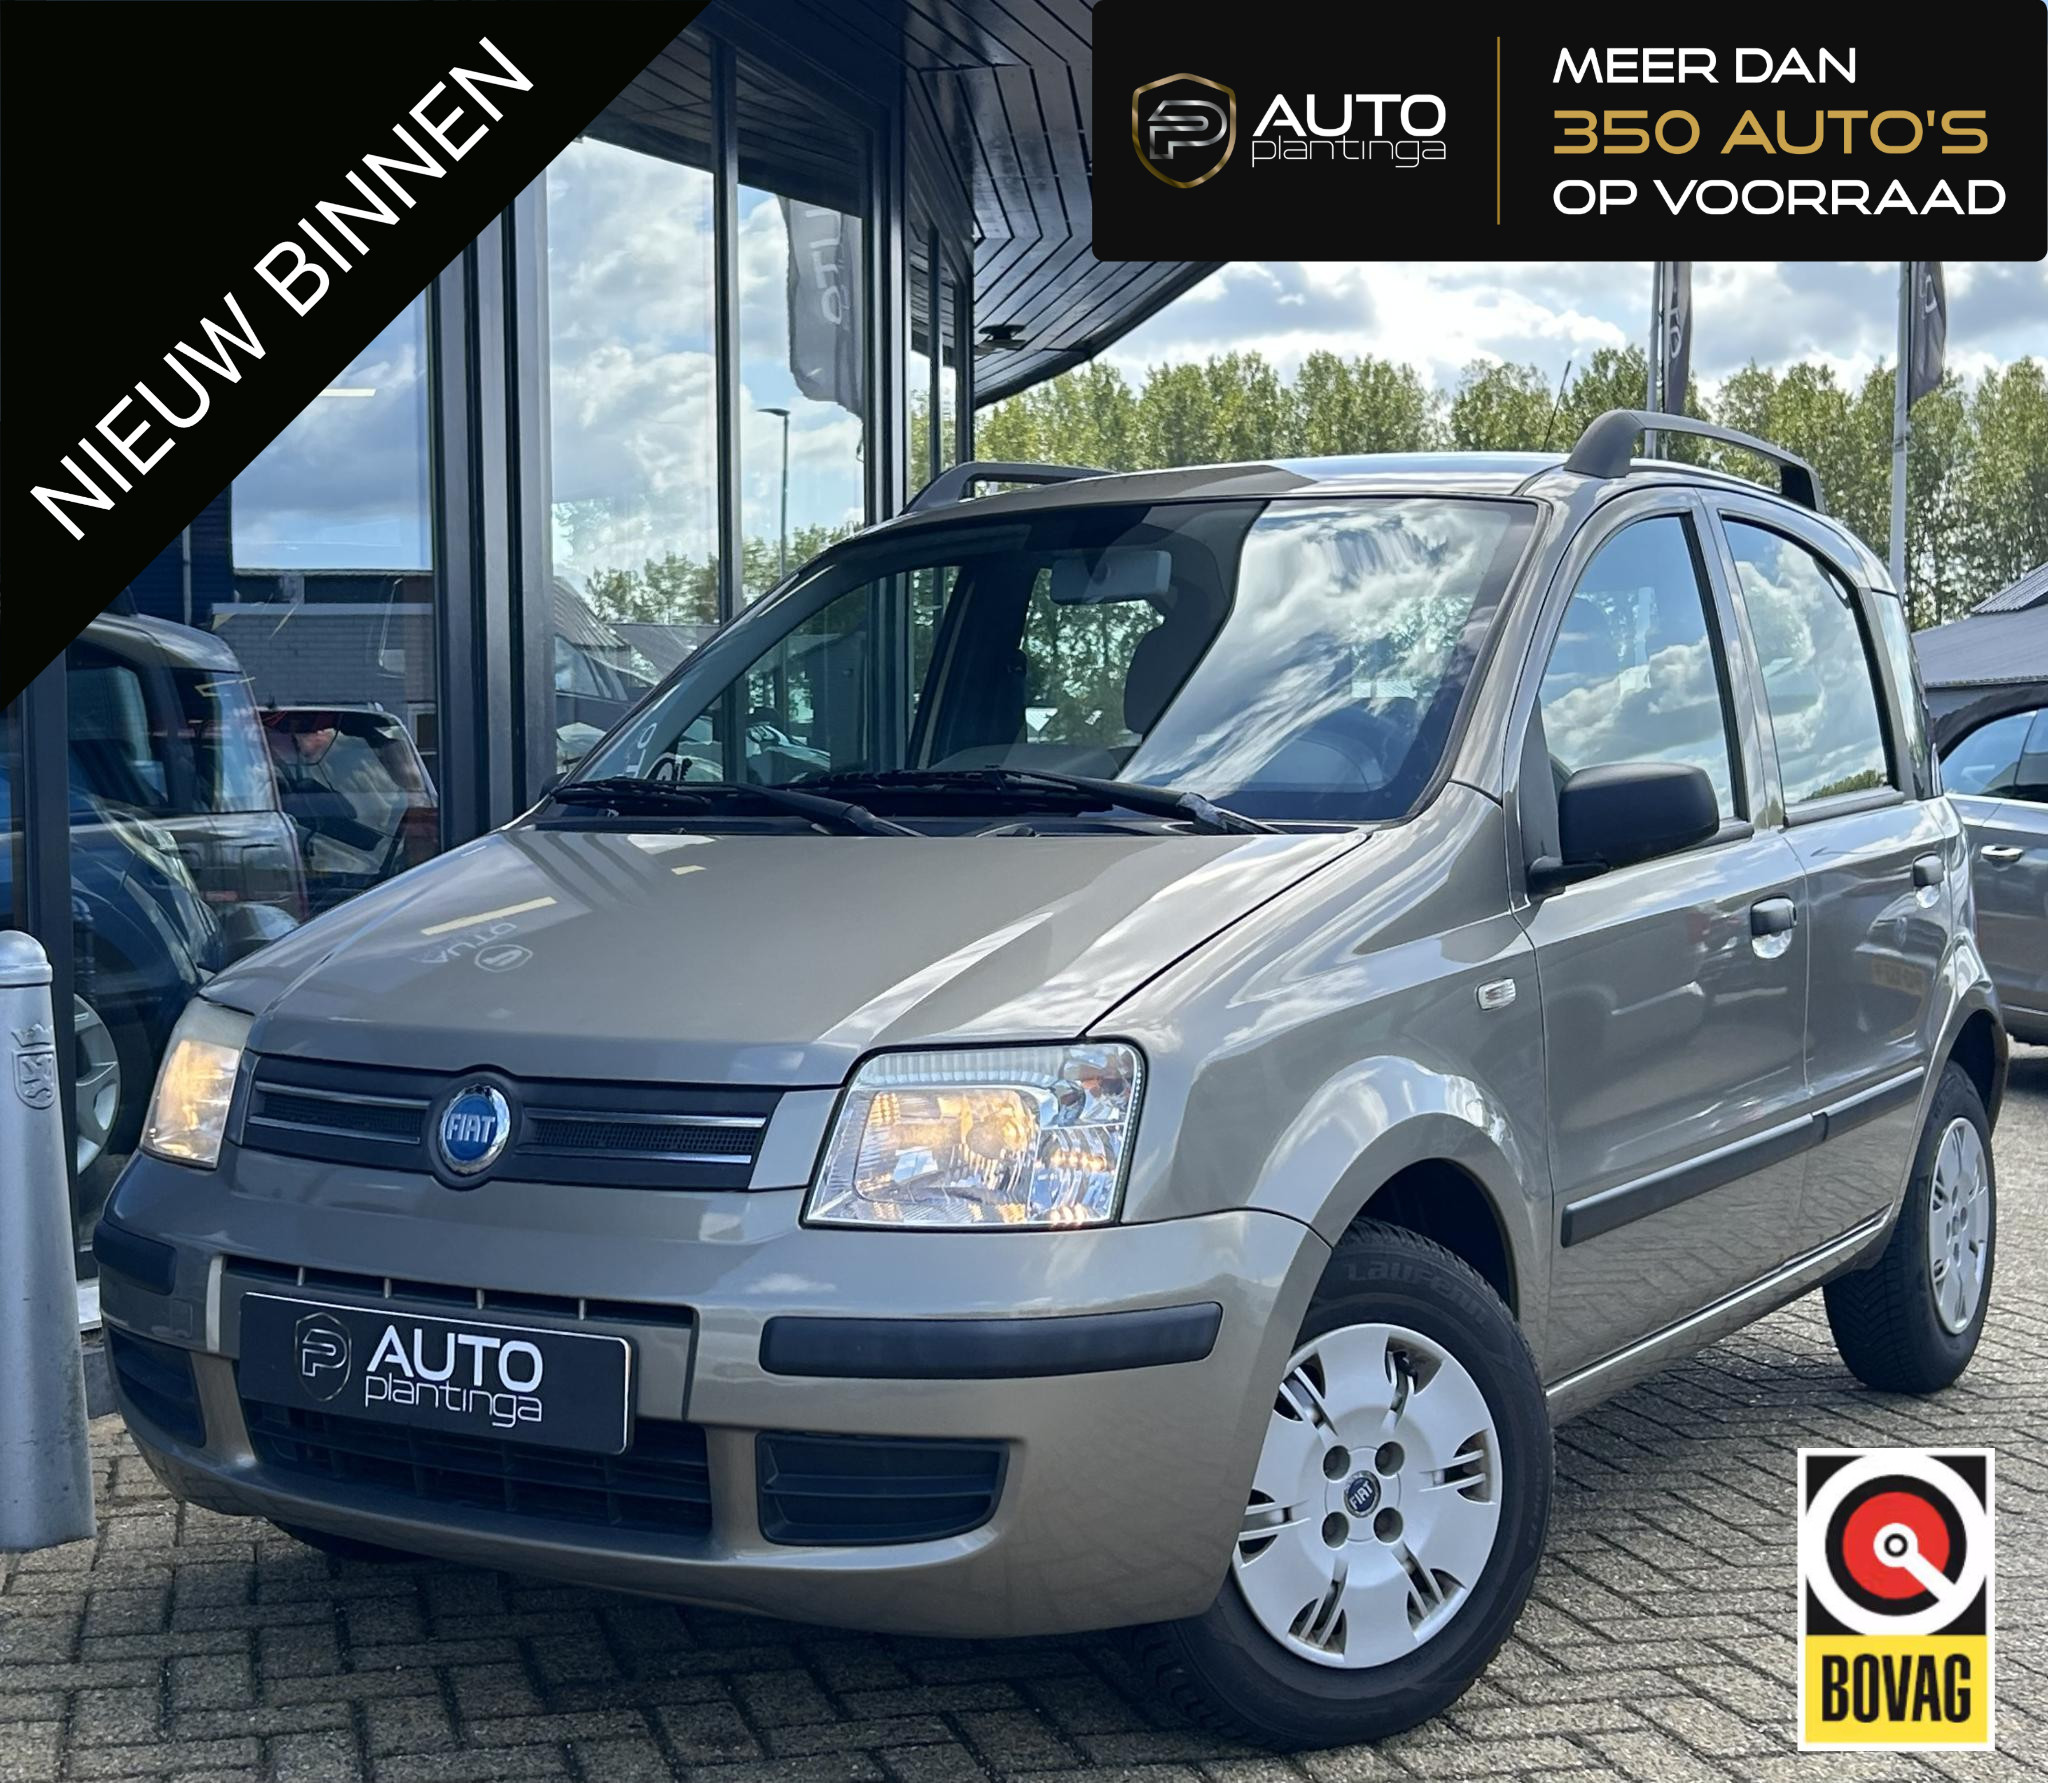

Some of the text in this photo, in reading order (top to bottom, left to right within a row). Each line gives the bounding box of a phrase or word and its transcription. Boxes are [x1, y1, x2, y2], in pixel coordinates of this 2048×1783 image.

[446, 1113, 496, 1143] FIAT
[367, 1325, 543, 1393] AUTO
[365, 1371, 543, 1428] plantinga
[1349, 1480, 1373, 1510] FIAT
